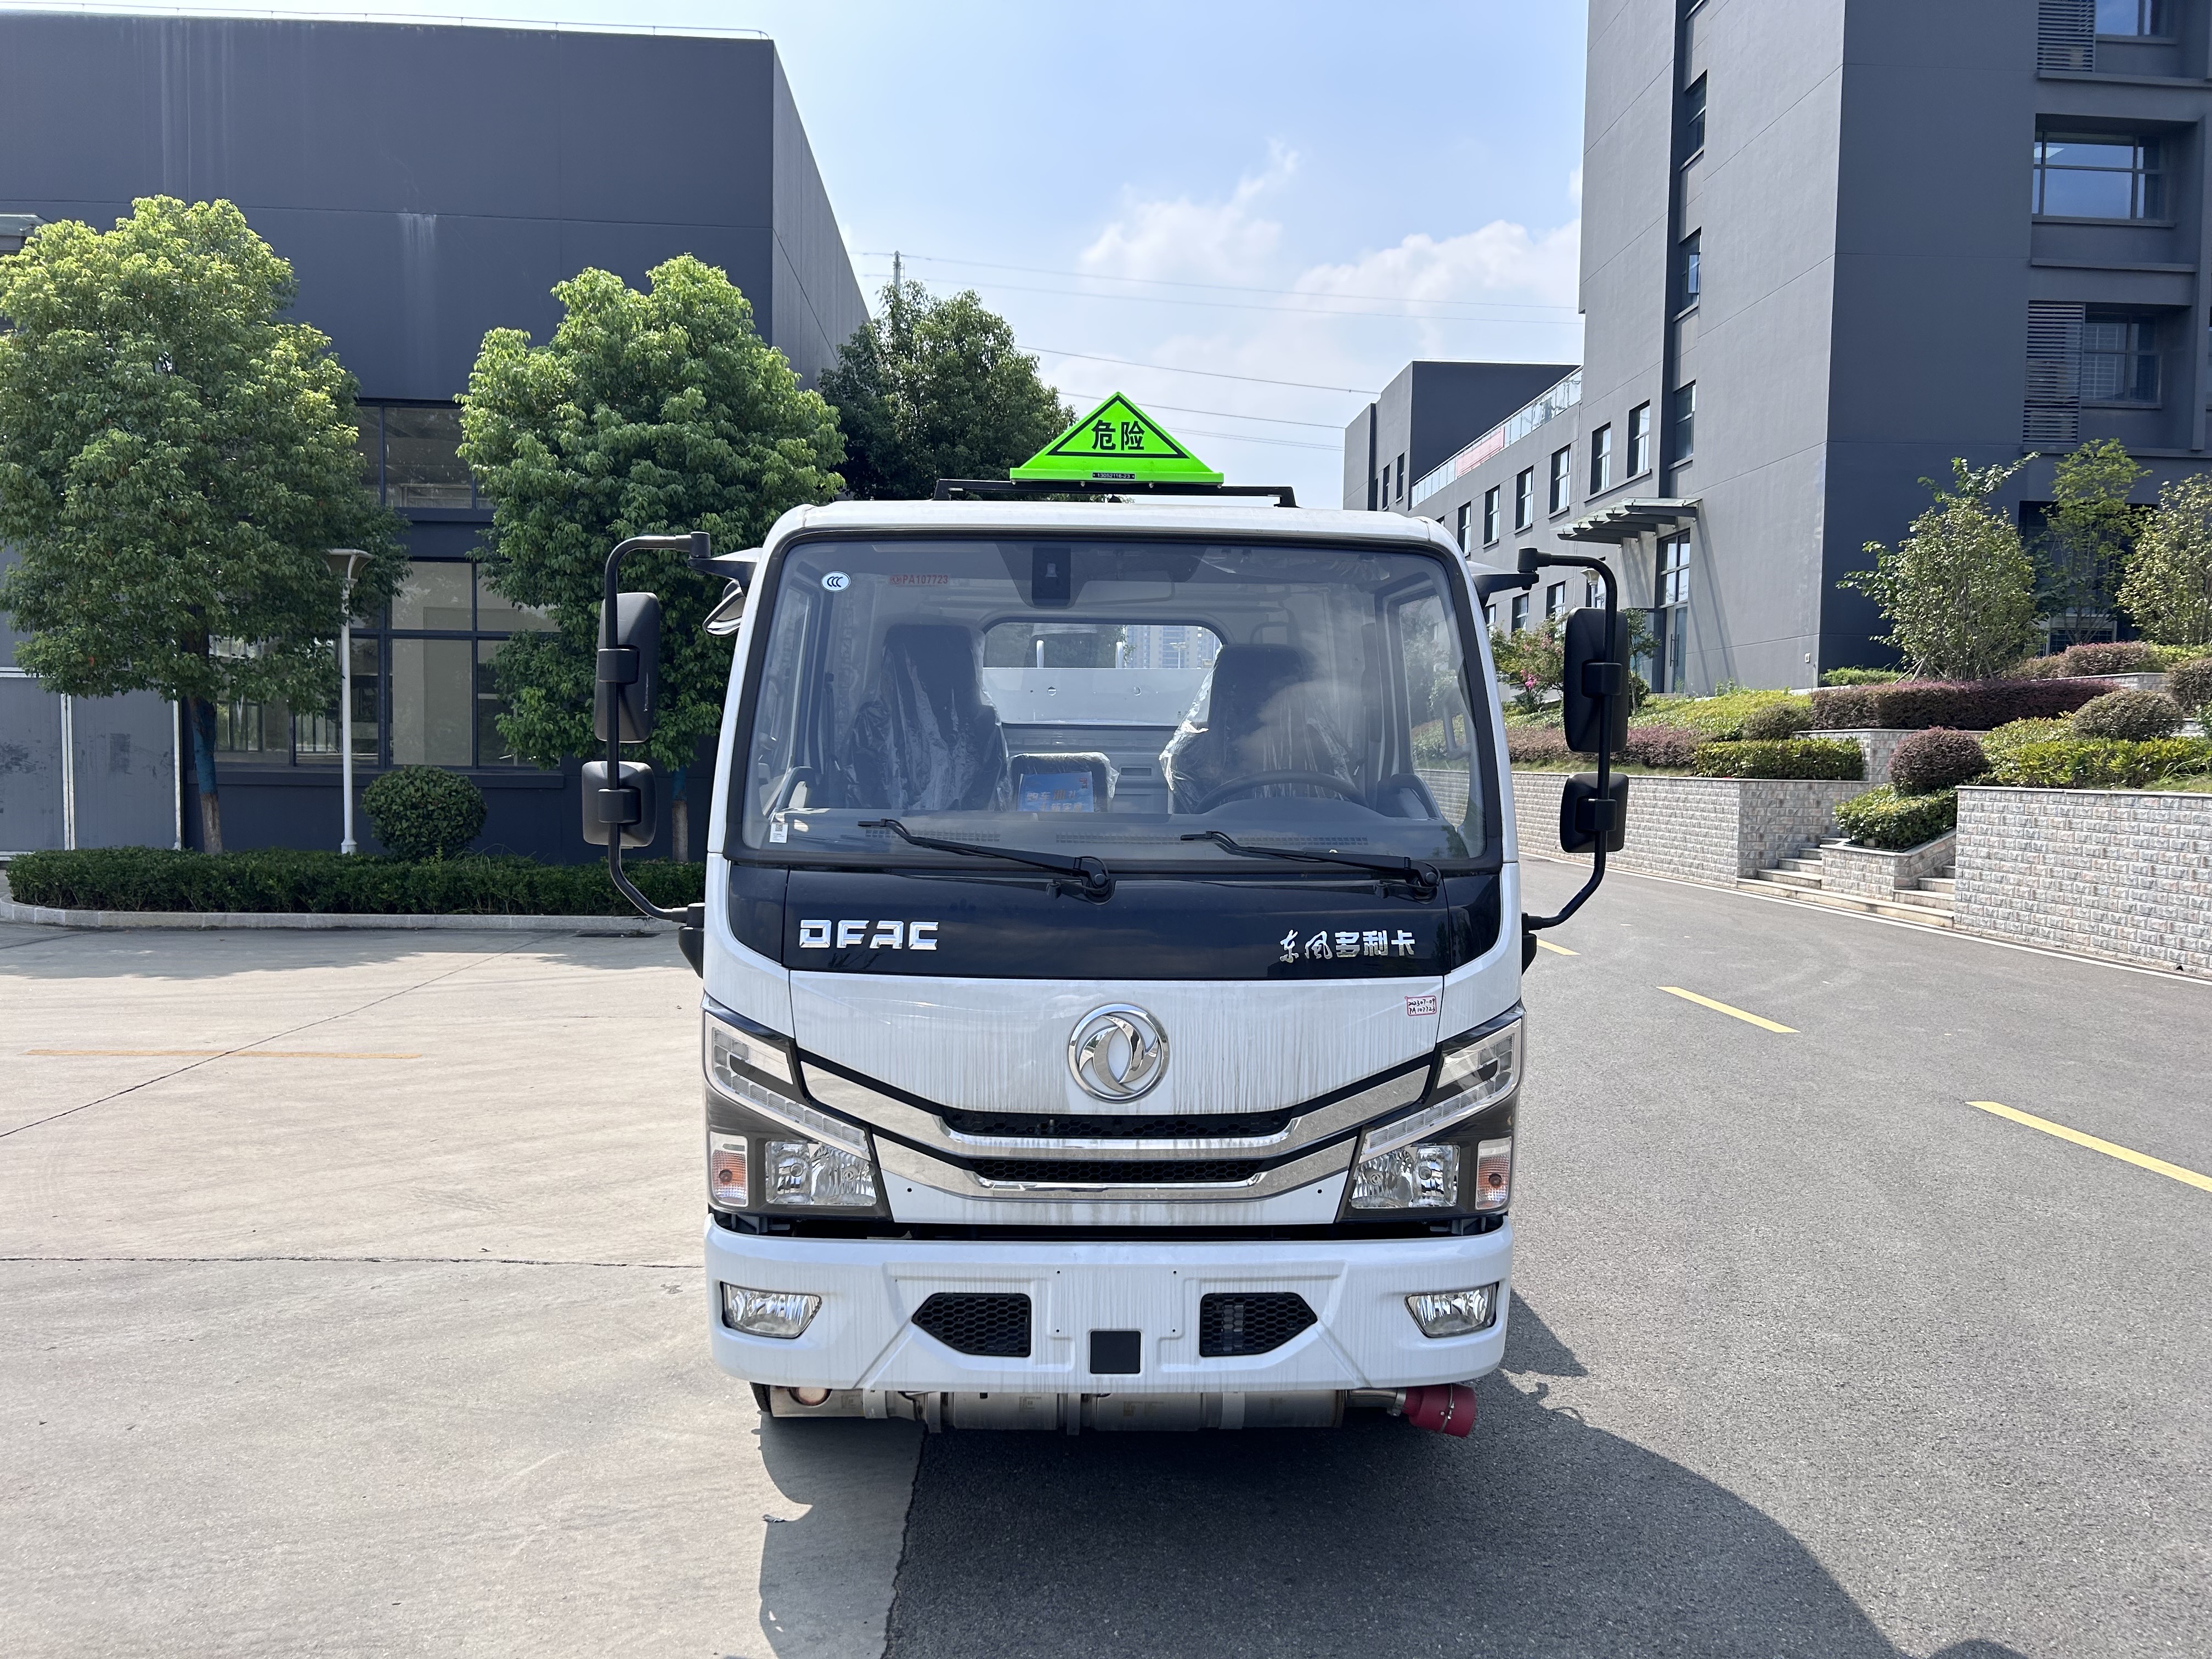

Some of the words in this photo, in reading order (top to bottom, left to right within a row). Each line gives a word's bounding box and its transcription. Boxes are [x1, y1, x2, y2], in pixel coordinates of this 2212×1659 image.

[1091, 420, 1146, 450] 危险
[827, 576, 844, 588] CCC
[903, 574, 949, 584] PA107723
[799, 919, 939, 951] DFAC
[1279, 929, 1415, 963] 东风多利卡
